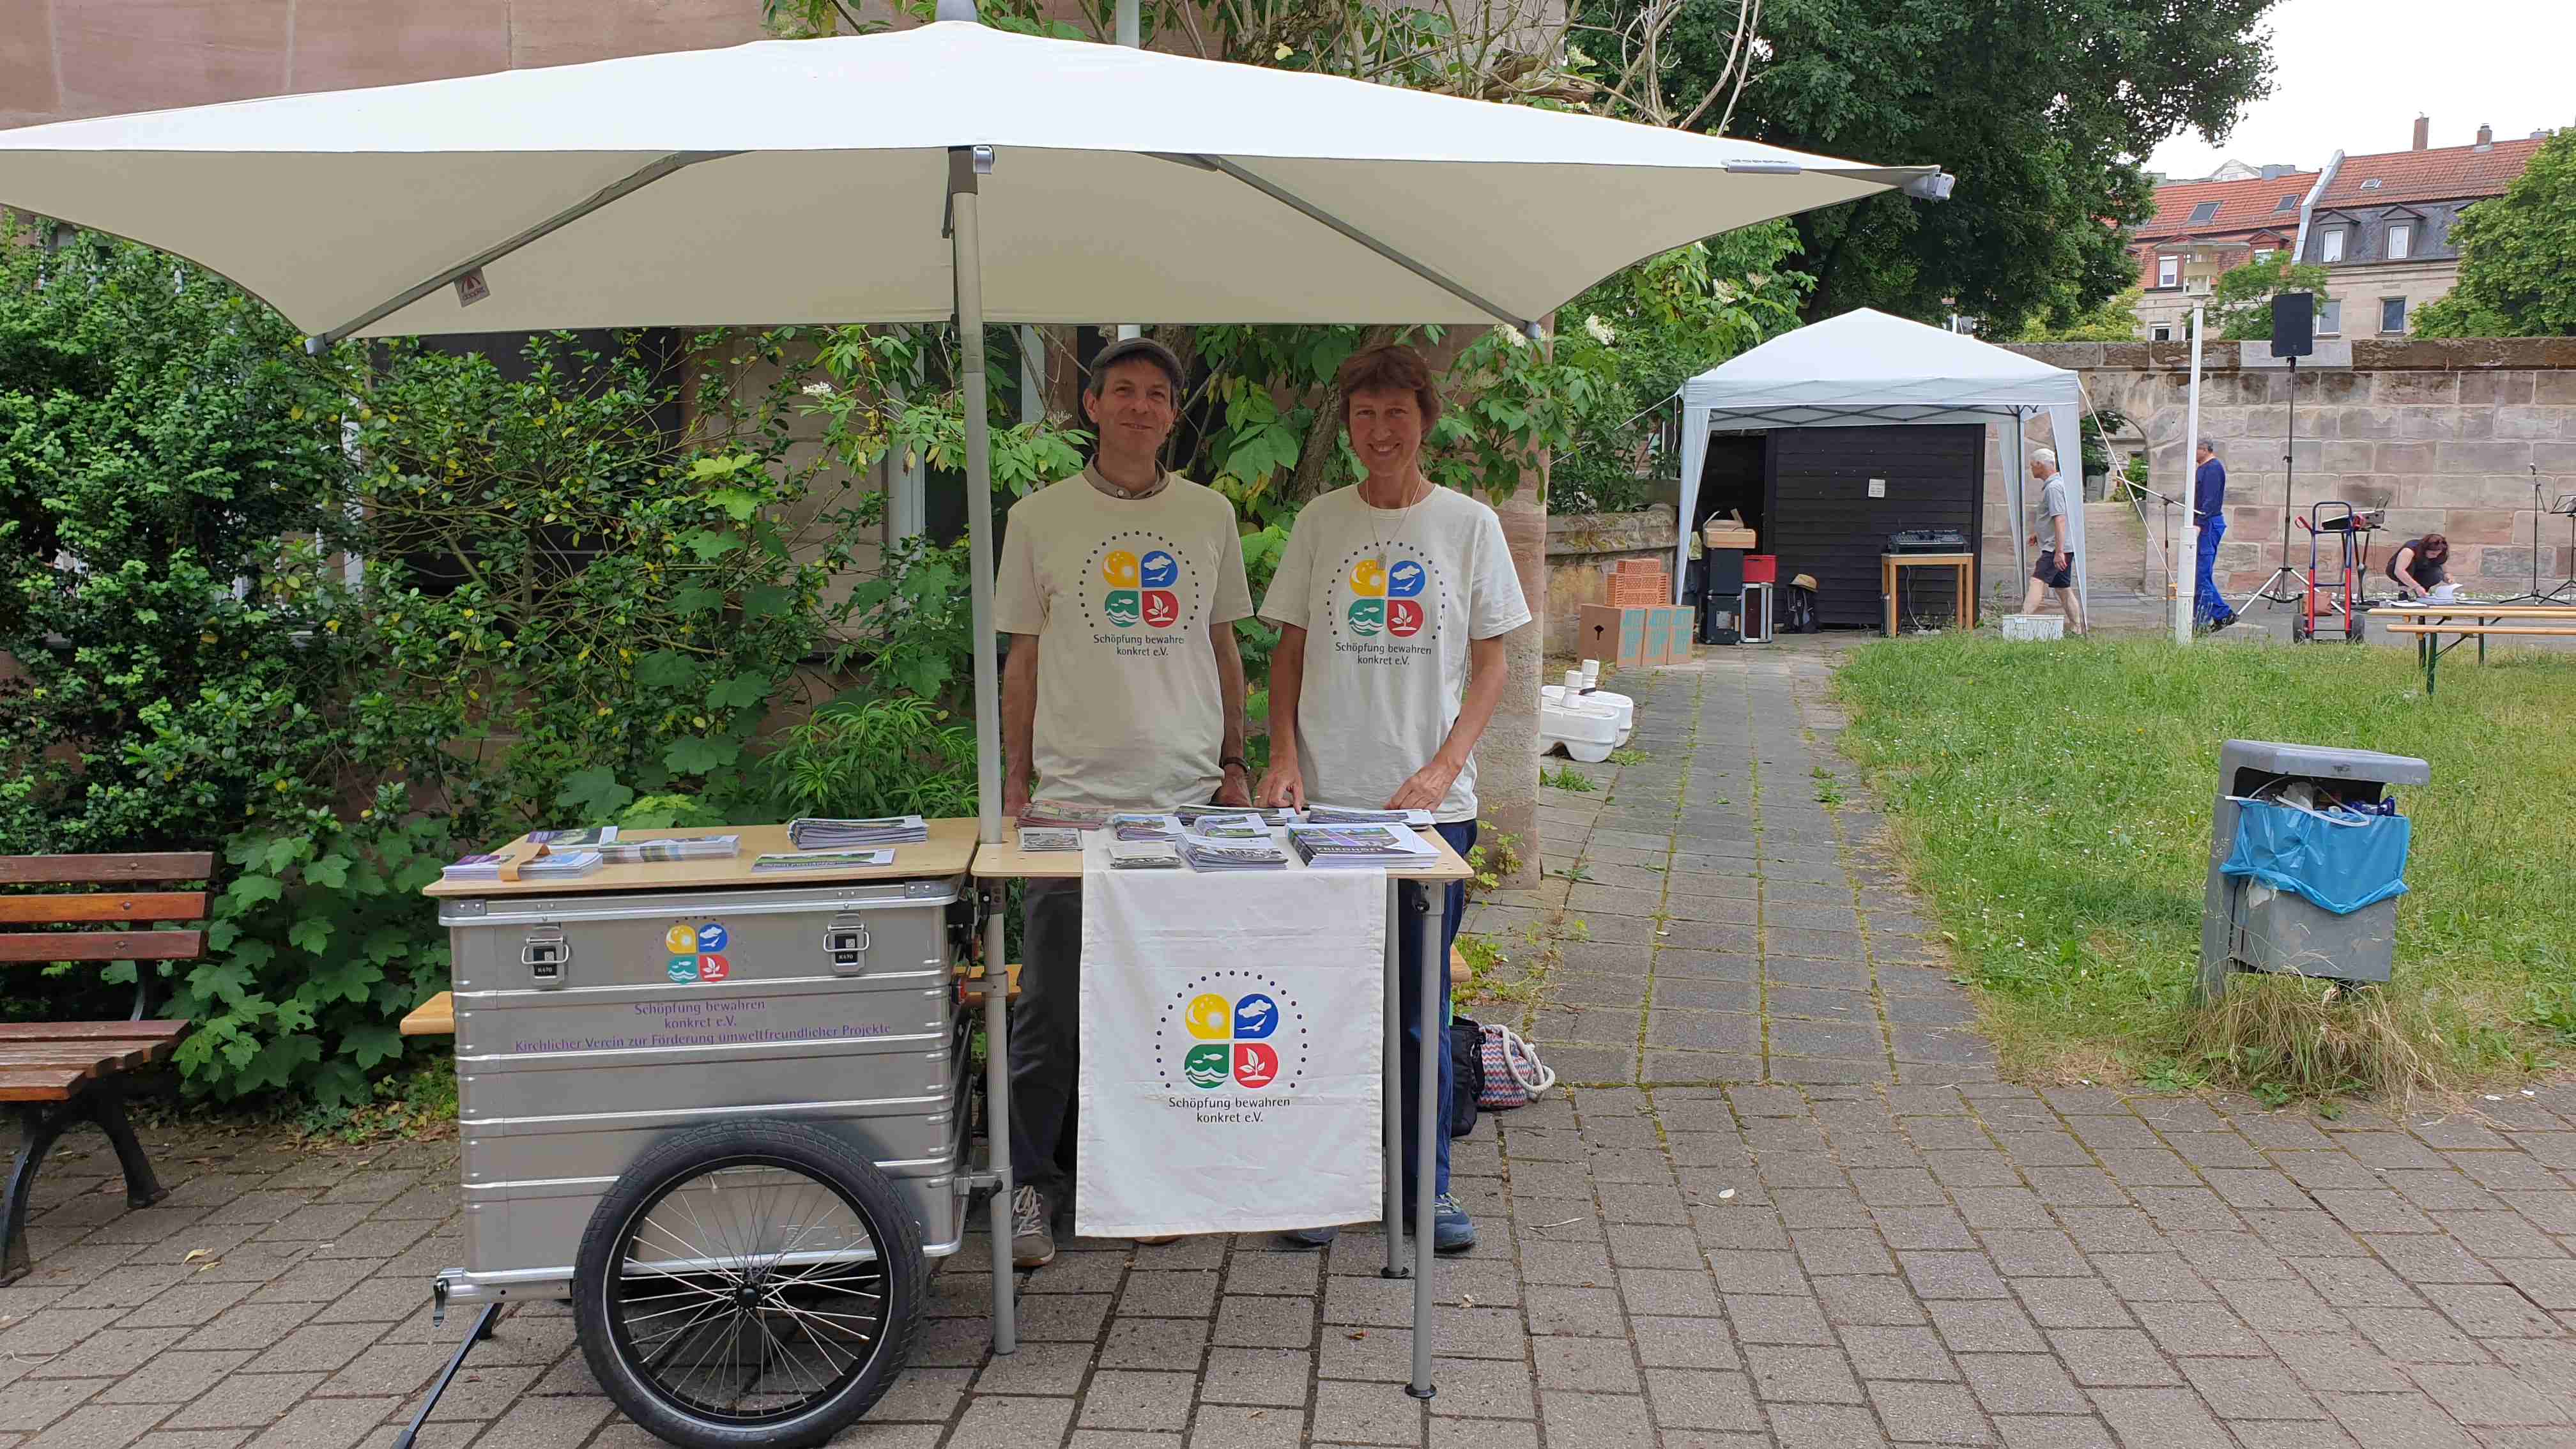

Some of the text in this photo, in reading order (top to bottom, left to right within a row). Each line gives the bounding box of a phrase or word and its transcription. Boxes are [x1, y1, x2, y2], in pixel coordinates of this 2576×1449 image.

[1093, 634, 1142, 646] Schöpfung
[1117, 647, 1169, 656] konkret e.V.
[1335, 642, 1432, 655] Schöpfung bewahren
[1357, 655, 1410, 665] konkret e.V.
[634, 1000, 765, 1016] Schöpfung bewahren
[664, 1015, 737, 1029] konkret e.V.
[515, 1038, 581, 1052] Kirchlicher
[585, 1036, 624, 1049] Verein
[628, 1038, 648, 1046] zur
[652, 1032, 714, 1045] Förderung
[843, 1022, 891, 1036] Projekte
[1169, 1097, 1291, 1110] Schöpfung bewahren
[1197, 1112, 1263, 1123] konkret e.V.
